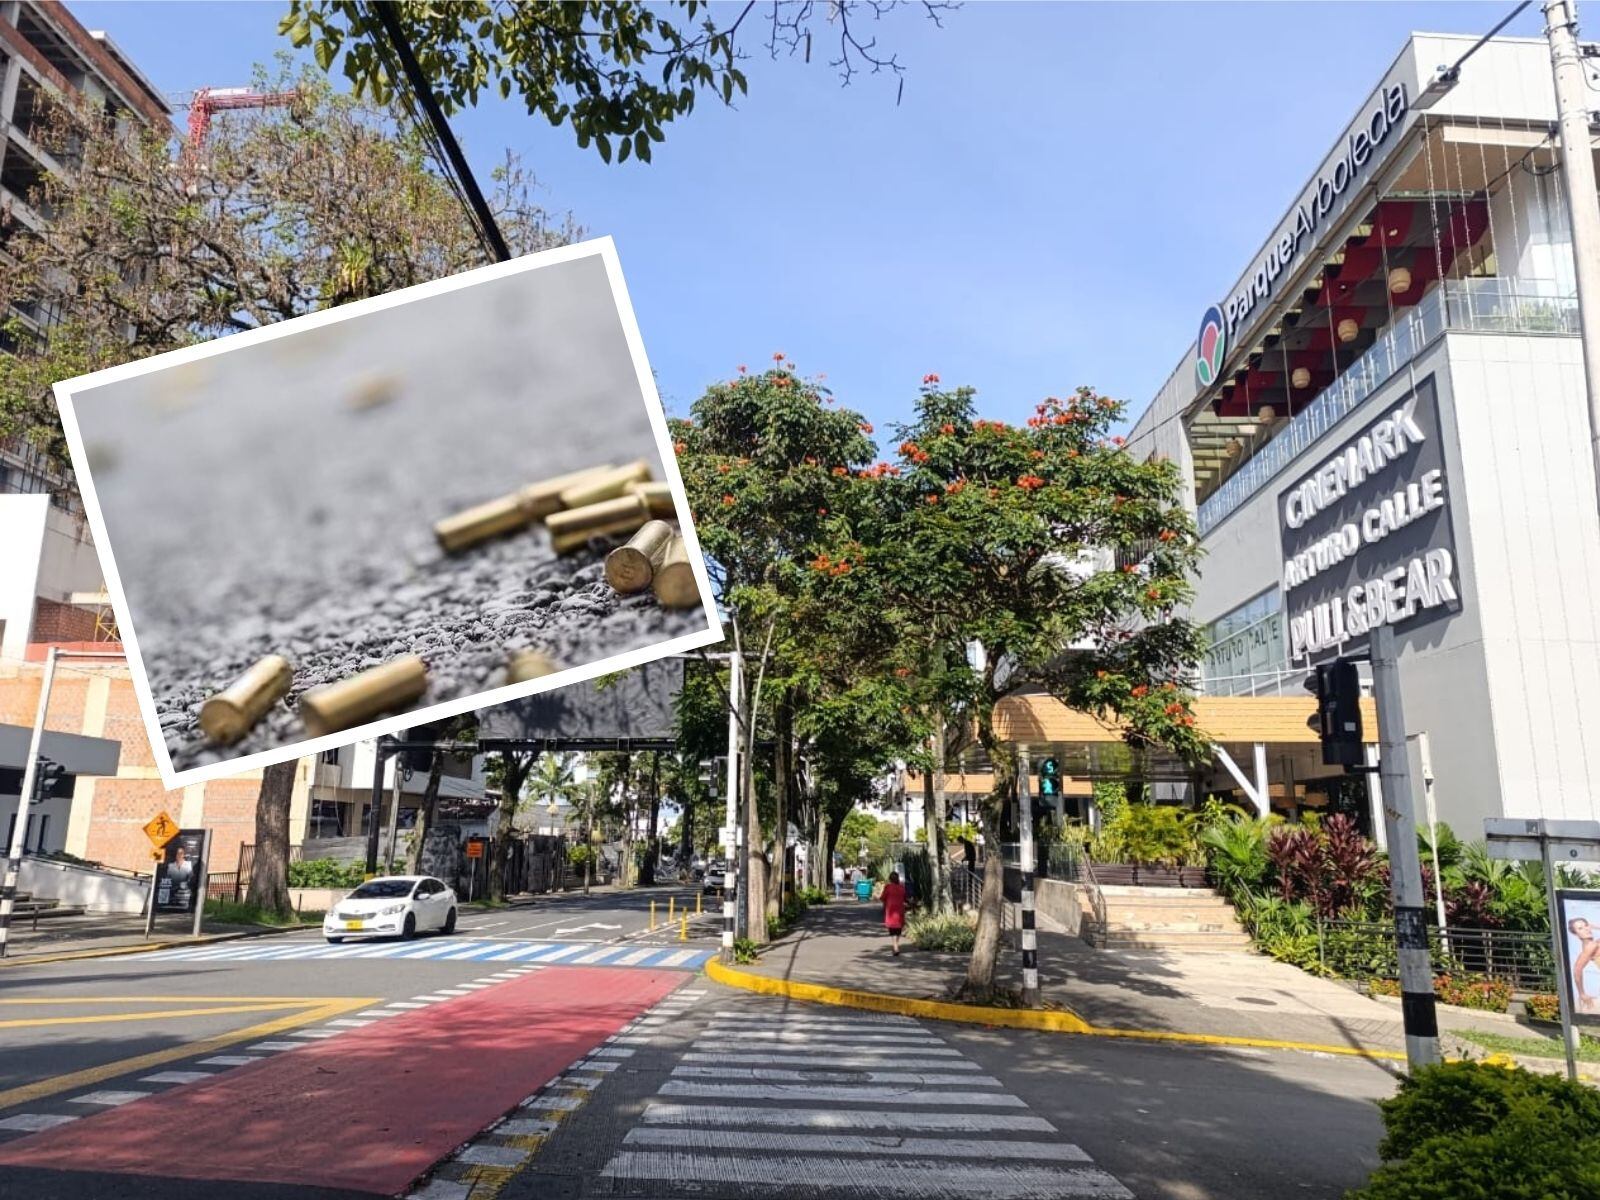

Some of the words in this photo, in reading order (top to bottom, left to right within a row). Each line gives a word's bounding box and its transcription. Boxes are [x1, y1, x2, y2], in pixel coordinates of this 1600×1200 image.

[1285, 397, 1426, 529] CINEMARK
[1284, 523, 1359, 591] ARTURO
[1363, 469, 1445, 543] CALLE
[1290, 548, 1458, 660] PULL&BEAR
